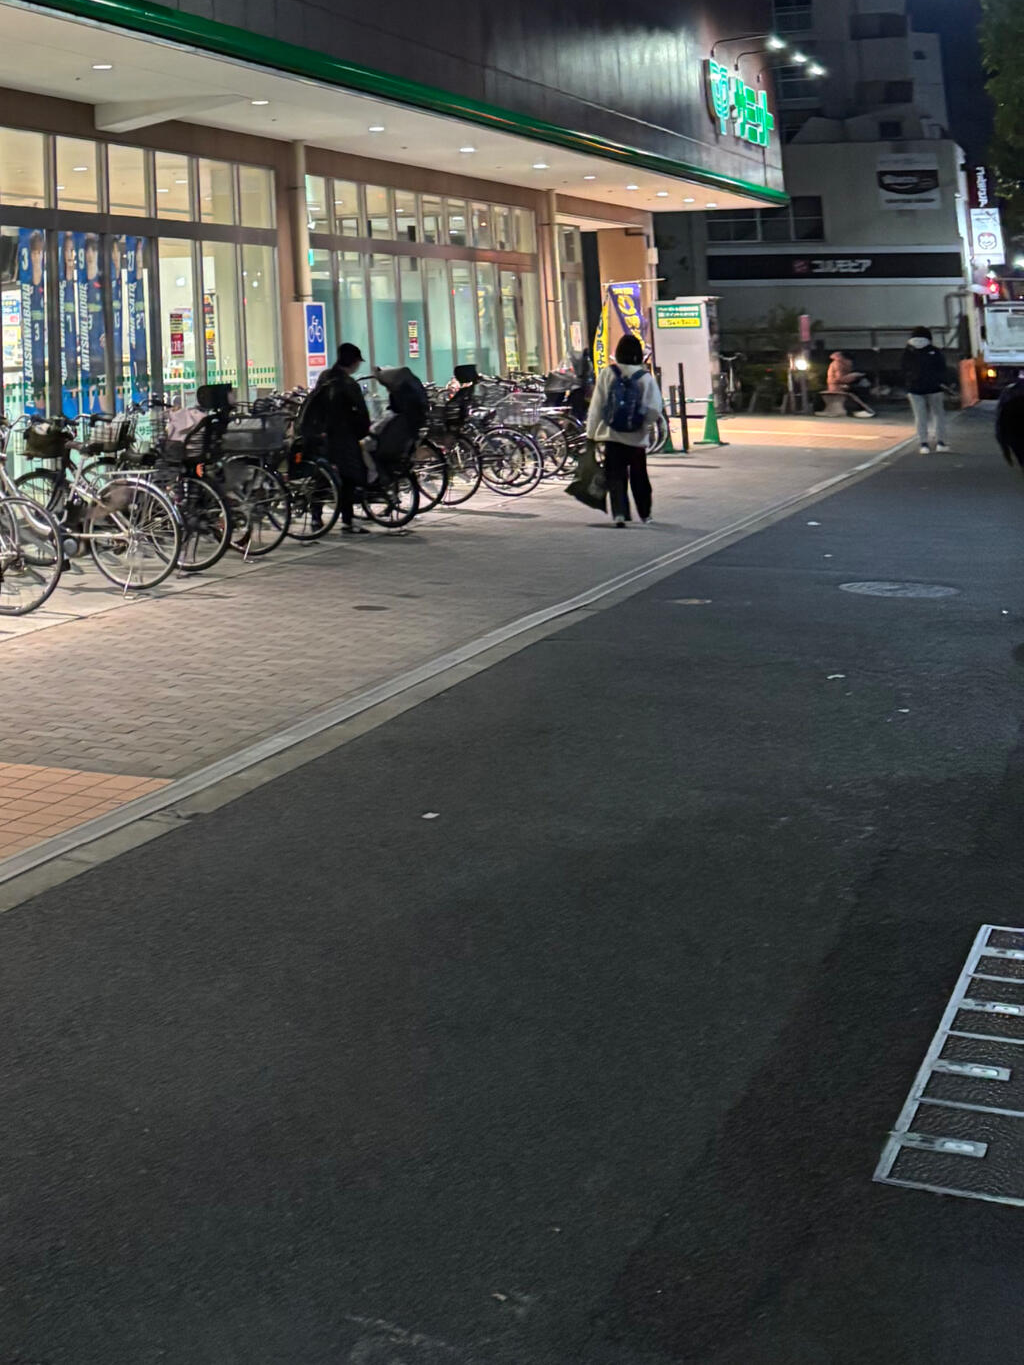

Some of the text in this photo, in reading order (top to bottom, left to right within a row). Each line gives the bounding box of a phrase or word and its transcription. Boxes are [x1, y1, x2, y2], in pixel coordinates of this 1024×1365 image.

[731, 76, 774, 148] サミット
[21, 247, 29, 271] 3
